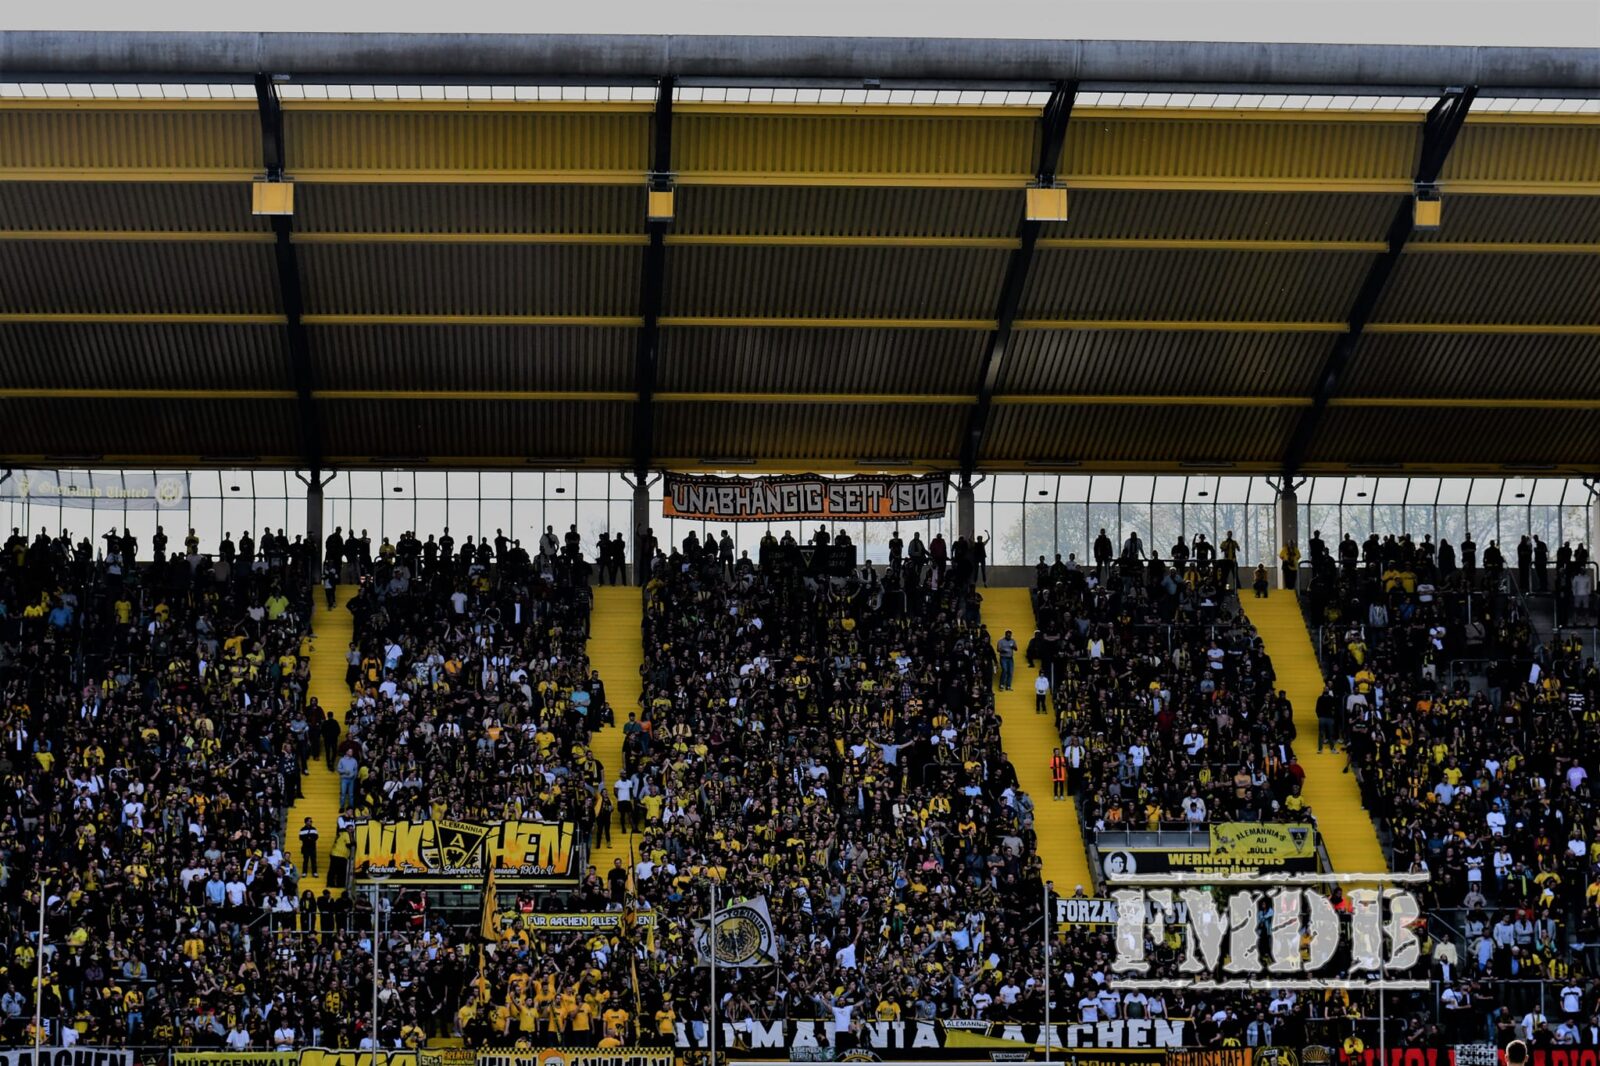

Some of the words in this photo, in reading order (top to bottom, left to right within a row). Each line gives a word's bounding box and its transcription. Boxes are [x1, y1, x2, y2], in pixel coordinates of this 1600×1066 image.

[671, 481, 823, 514] UNABHÄNGIG
[829, 482, 886, 513] SEIT
[889, 481, 945, 512] 1900
[439, 820, 483, 834] ALEMANNIA
[1168, 853, 1231, 865] WERNER
[520, 861, 541, 875] 1900
[1056, 900, 1115, 922] FORZA
[527, 914, 547, 926] FÜR
[550, 916, 588, 926] AACHEN
[590, 915, 618, 926] ALLES
[946, 1020, 988, 1030] ALEMANNIA
[1002, 1018, 1186, 1048] AACHEN
